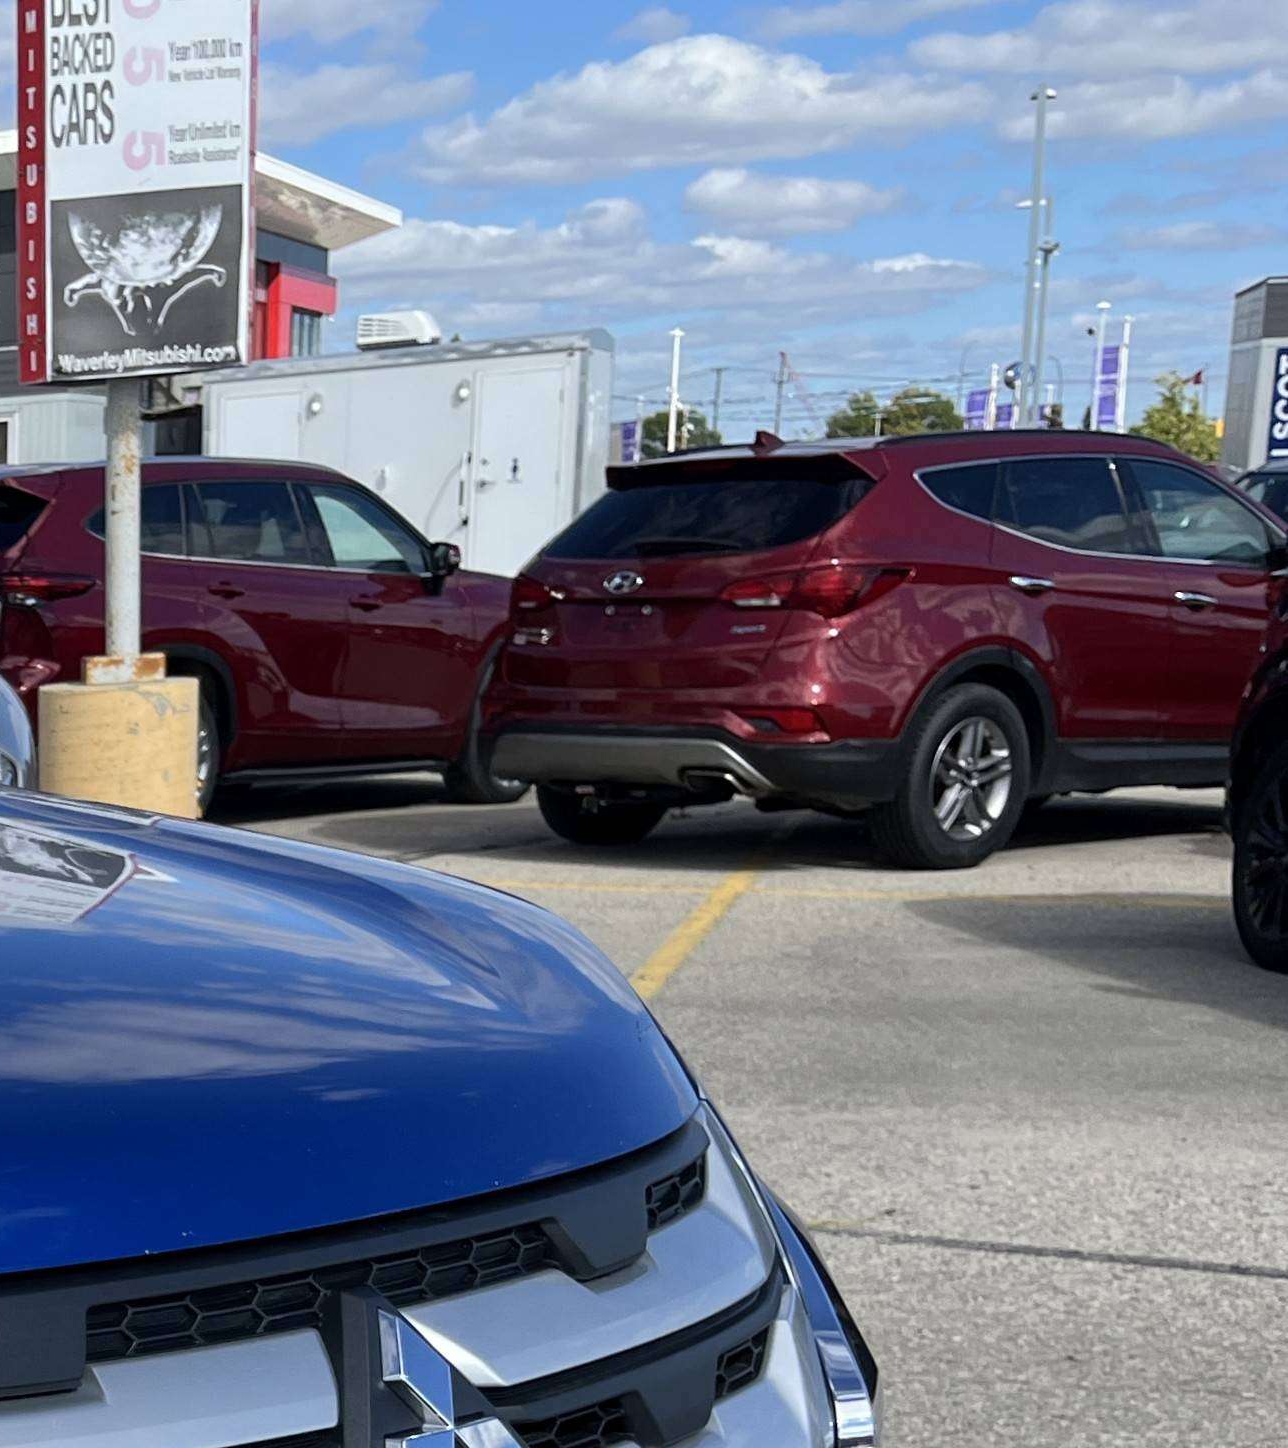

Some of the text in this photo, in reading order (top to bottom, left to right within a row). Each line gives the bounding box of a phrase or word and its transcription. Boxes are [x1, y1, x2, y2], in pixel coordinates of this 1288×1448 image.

[51, 32, 116, 77] BACKED
[50, 79, 115, 148] CARS
[25, 10, 38, 372] MITSUBISHI
